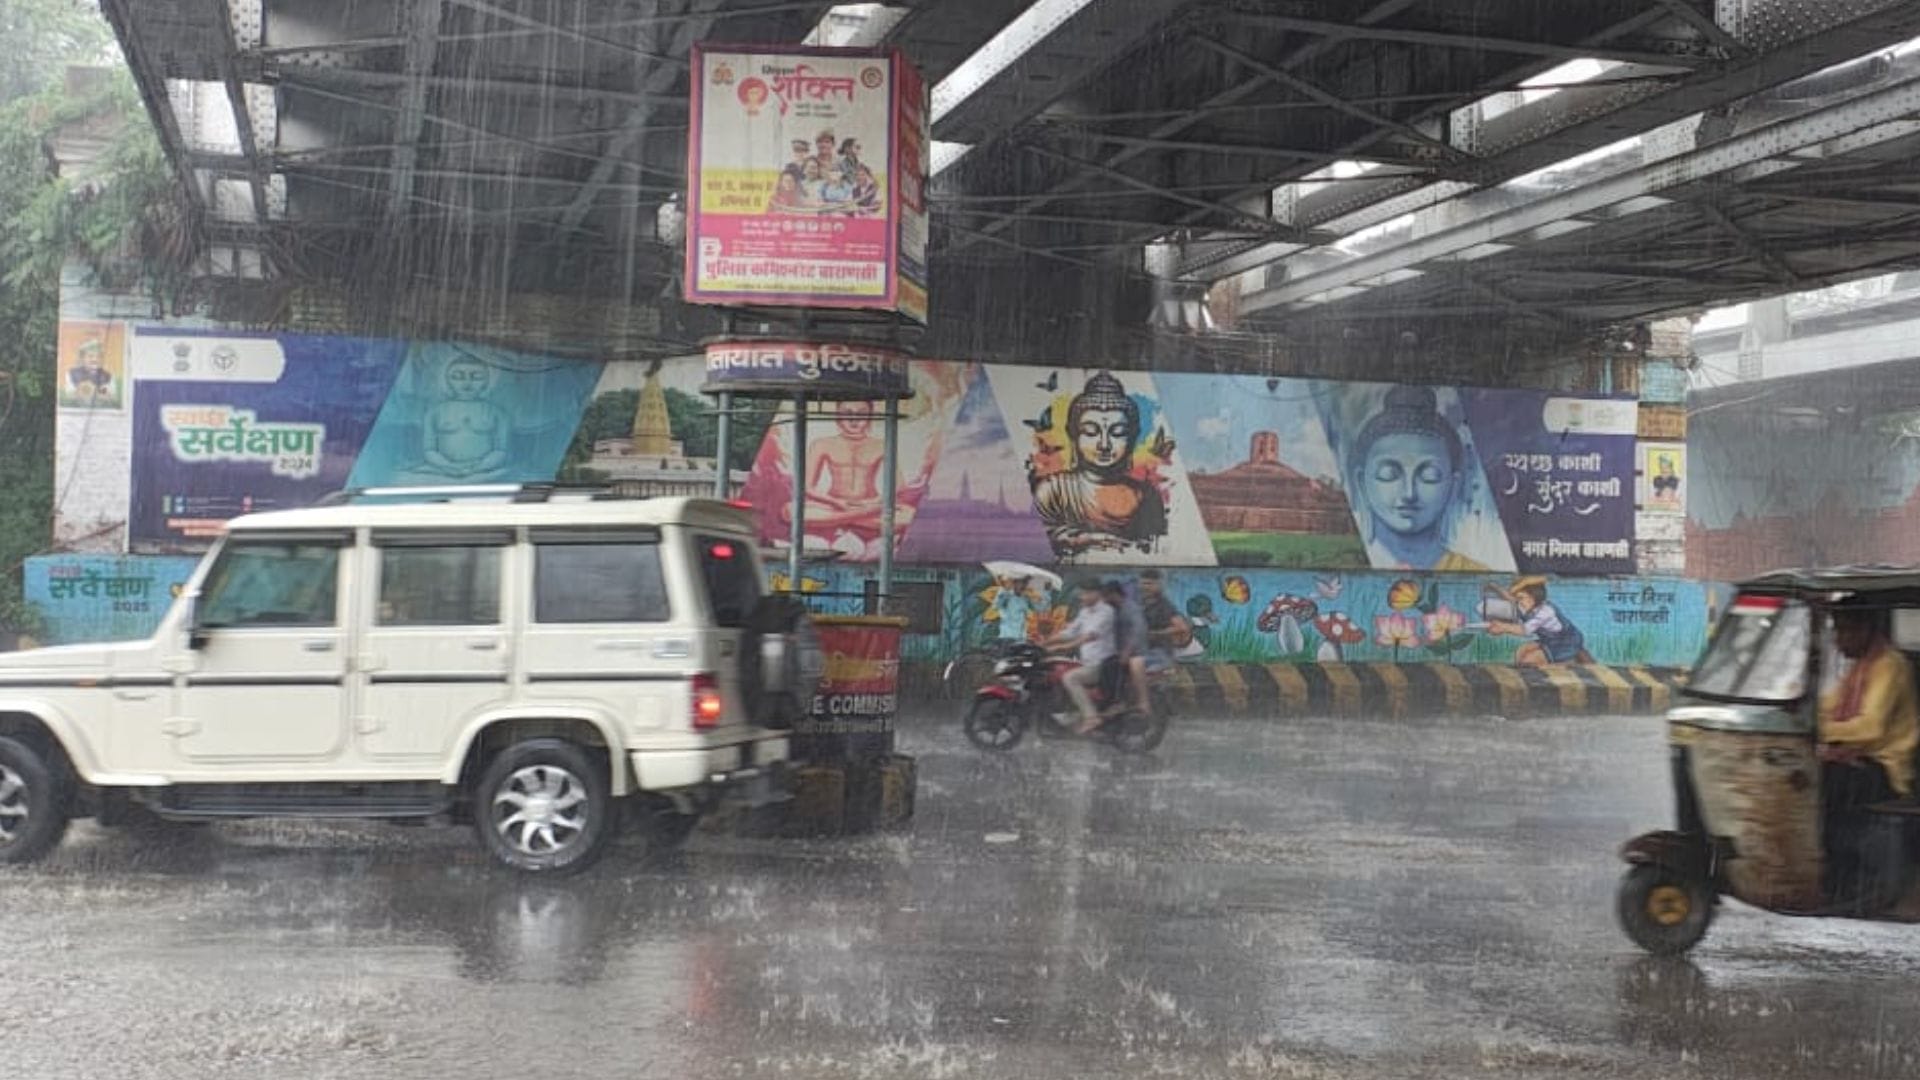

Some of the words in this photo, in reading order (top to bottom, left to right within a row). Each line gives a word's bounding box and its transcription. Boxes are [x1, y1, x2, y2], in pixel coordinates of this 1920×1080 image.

[795, 344, 882, 380] पुलिस
[178, 416, 319, 455] सर्वेक्षण
[1558, 451, 1603, 472] काशी
[1577, 477, 1622, 498] काशी
[49, 567, 155, 600] सर्वेक्षण
